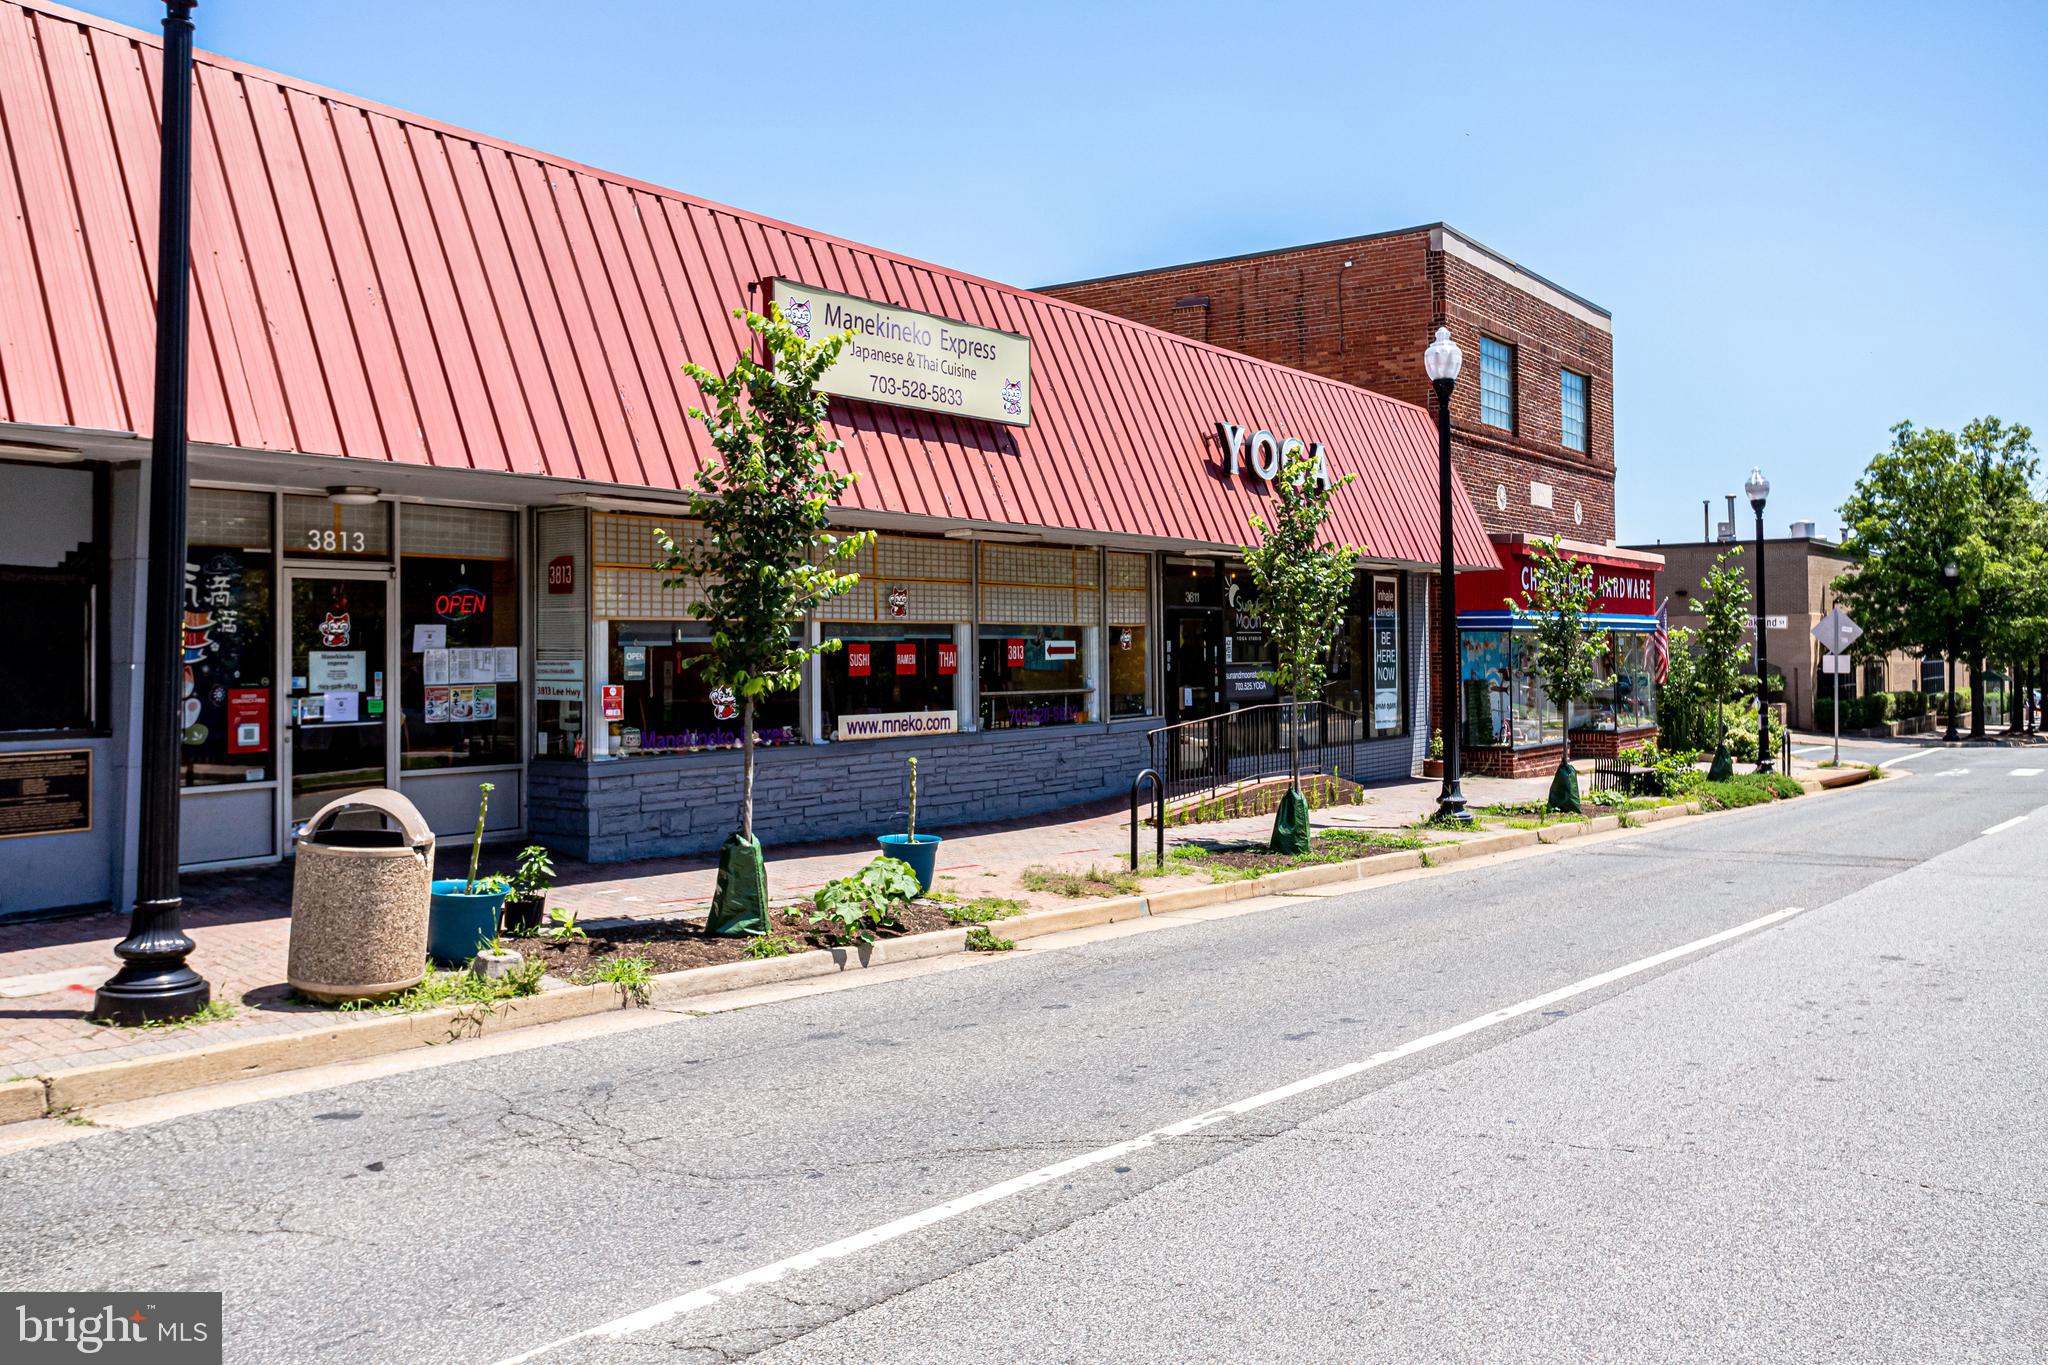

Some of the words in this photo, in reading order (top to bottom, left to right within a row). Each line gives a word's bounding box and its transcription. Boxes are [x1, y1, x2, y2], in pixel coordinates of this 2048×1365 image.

[824, 302, 932, 347] Manekineko
[940, 328, 997, 361] Express
[850, 341, 904, 365] Japanese
[906, 352, 915, 367] &
[916, 353, 939, 372] Thai
[940, 359, 977, 380] Cuisine
[869, 374, 963, 406] 703-528-5833
[307, 529, 365, 552] 3813
[549, 565, 572, 584] 3813
[1377, 589, 1394, 602] inhale
[1599, 575, 1651, 600] HARDWARE
[436, 595, 486, 614] OPEN
[1743, 617, 1777, 628] Oaknd
[1381, 631, 1391, 645] BE
[849, 653, 870, 667] SUSHI
[896, 653, 916, 666] RAMEN
[939, 651, 957, 667] THAI
[1008, 645, 1024, 660] 3813
[1376, 649, 1396, 663] HERE
[1377, 667, 1395, 680] NOW
[537, 686, 551, 696] 3813
[553, 687, 564, 696] Lee
[566, 687, 581, 699] Hwy
[846, 715, 951, 736] www.mneko.com
[641, 727, 735, 749] Manekneko
